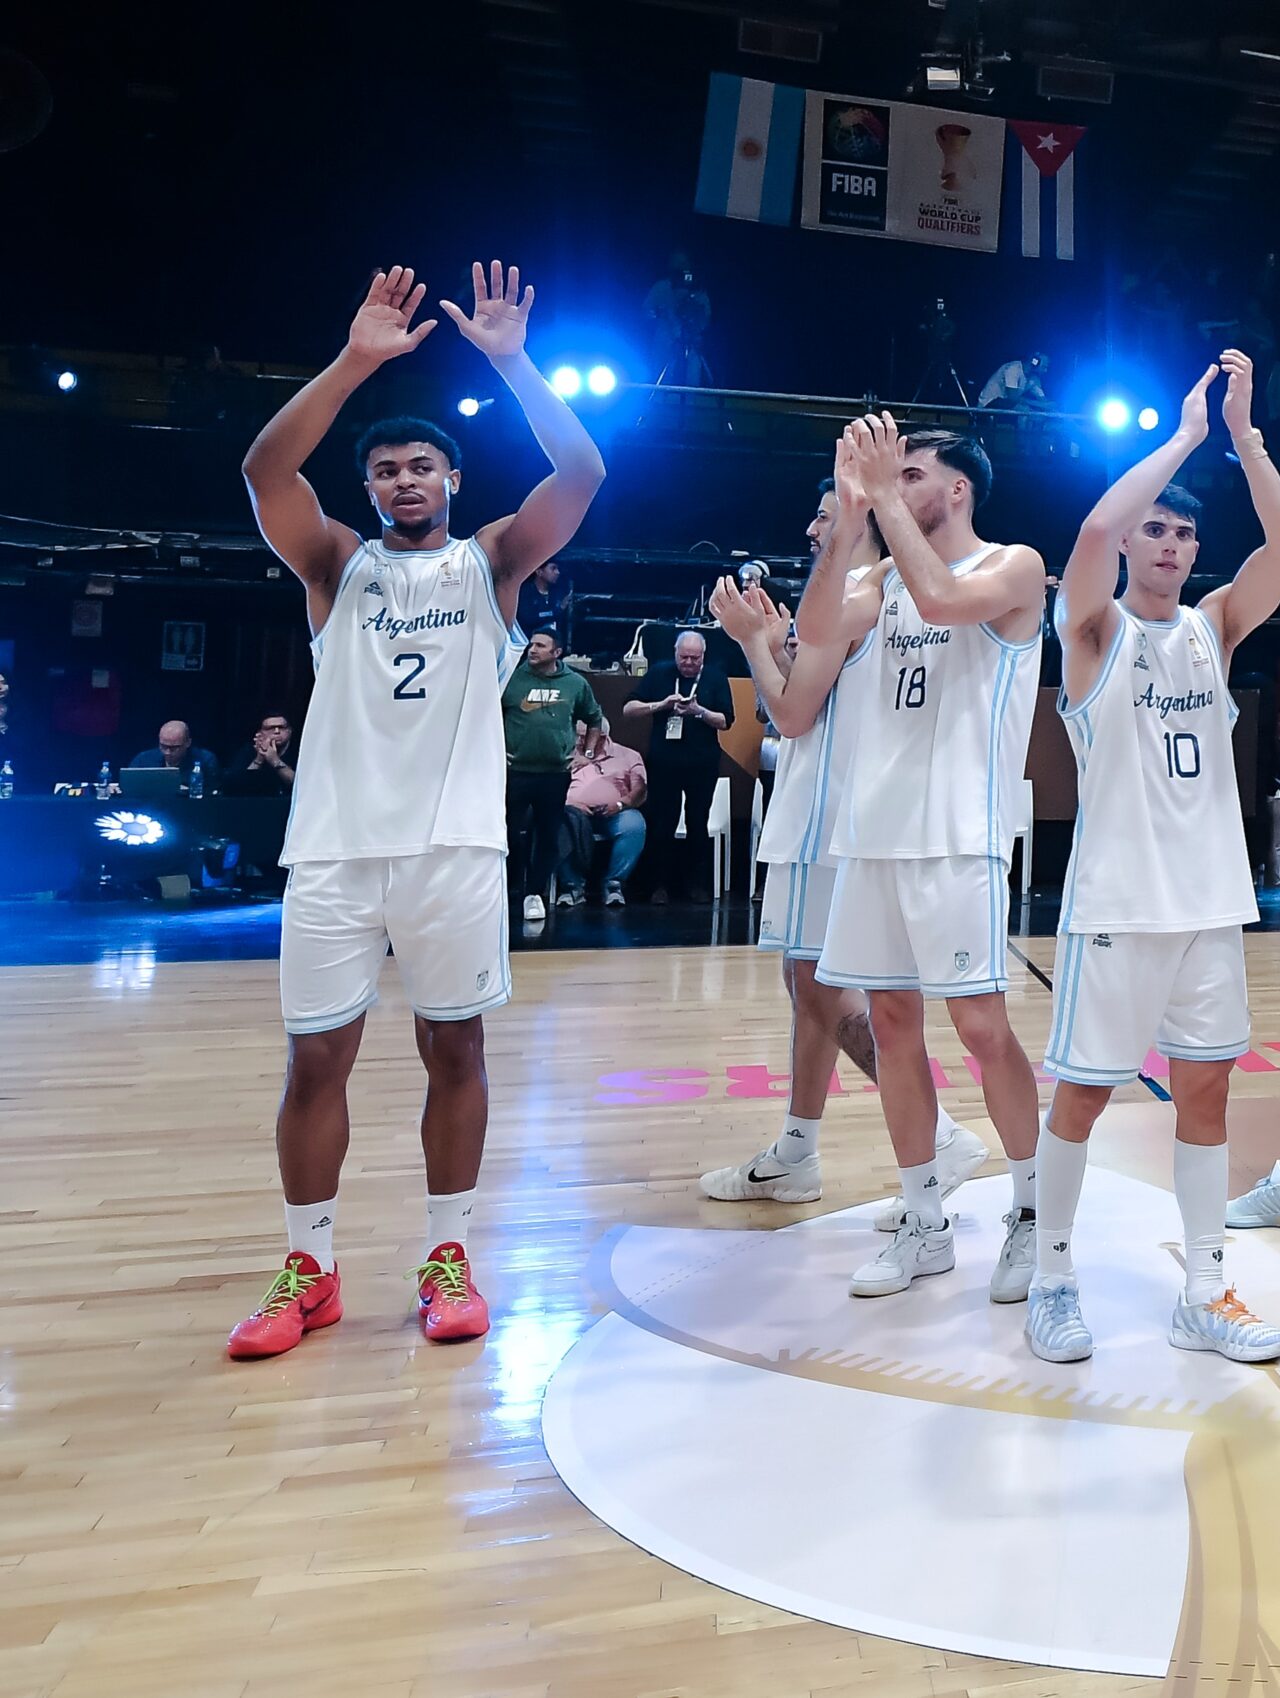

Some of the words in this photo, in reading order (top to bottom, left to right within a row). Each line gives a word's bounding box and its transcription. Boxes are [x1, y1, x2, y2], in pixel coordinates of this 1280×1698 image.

[831, 173, 876, 197] FIBA
[917, 217, 981, 236] QUALIFIERS
[919, 207, 958, 221] WORLD
[960, 213, 982, 223] CUP
[362, 607, 468, 640] Argentina
[393, 653, 426, 700] 2
[895, 666, 926, 710] 18
[1164, 732, 1201, 778] 10
